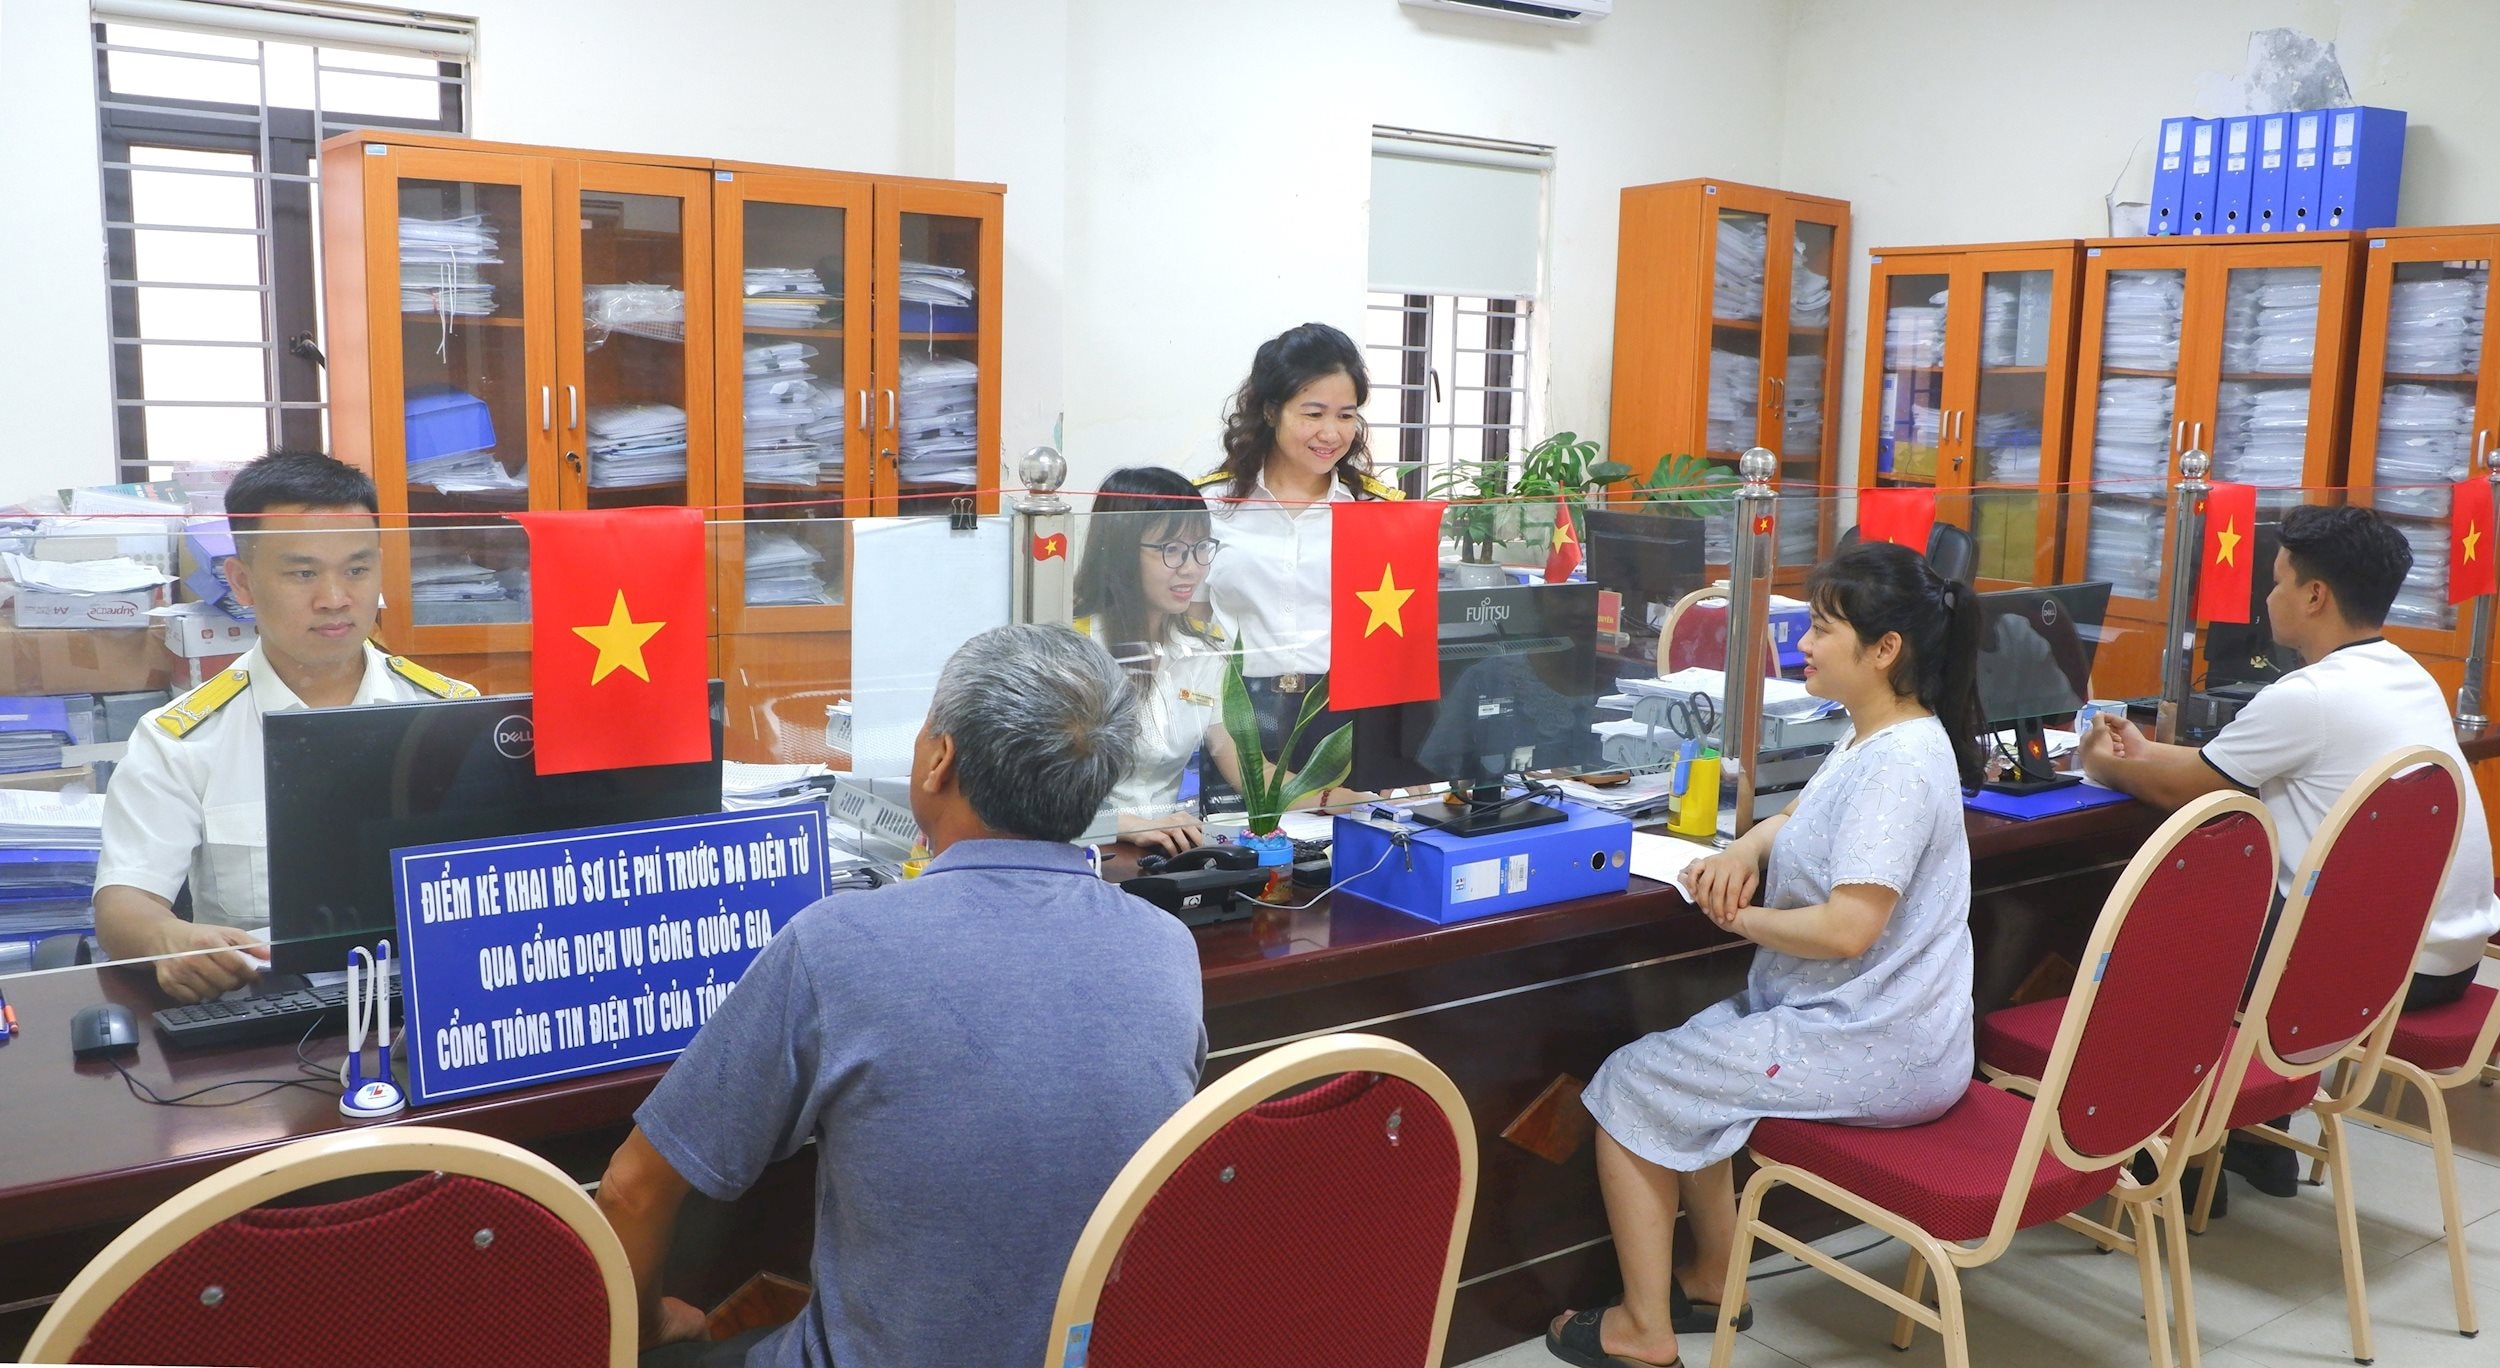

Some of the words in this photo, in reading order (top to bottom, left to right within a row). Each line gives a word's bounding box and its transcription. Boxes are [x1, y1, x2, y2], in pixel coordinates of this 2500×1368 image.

[54, 606, 70, 616] A4
[1466, 600, 1510, 625] FUJITSU
[499, 731, 534, 744] DELL
[420, 860, 473, 924] ĐIỂM
[475, 864, 502, 917] KÊ
[504, 867, 549, 913] KHAI
[551, 848, 578, 907] HỒ
[581, 857, 606, 903] SƠ
[609, 849, 631, 907] LỆ
[632, 845, 664, 896] PHÍ
[665, 840, 720, 892] TRƯỚC
[722, 844, 747, 891] BẠ
[748, 832, 787, 887] ĐIỆN
[788, 825, 810, 875] TỬ
[479, 944, 518, 992] QUA
[521, 922, 571, 984] CỔNG
[573, 930, 617, 983] DỊCH
[619, 926, 645, 975] VỤ
[647, 914, 694, 964] CÔNG
[697, 898, 741, 959] QUỐC
[744, 908, 773, 950] GIA
[436, 1007, 489, 1071] CỔNG
[491, 1007, 552, 1061] THÔNG
[554, 1006, 585, 1050] TIN
[588, 995, 630, 1050] ĐIỆN
[632, 983, 655, 1036] TỬ
[658, 978, 694, 1033] CỦA
